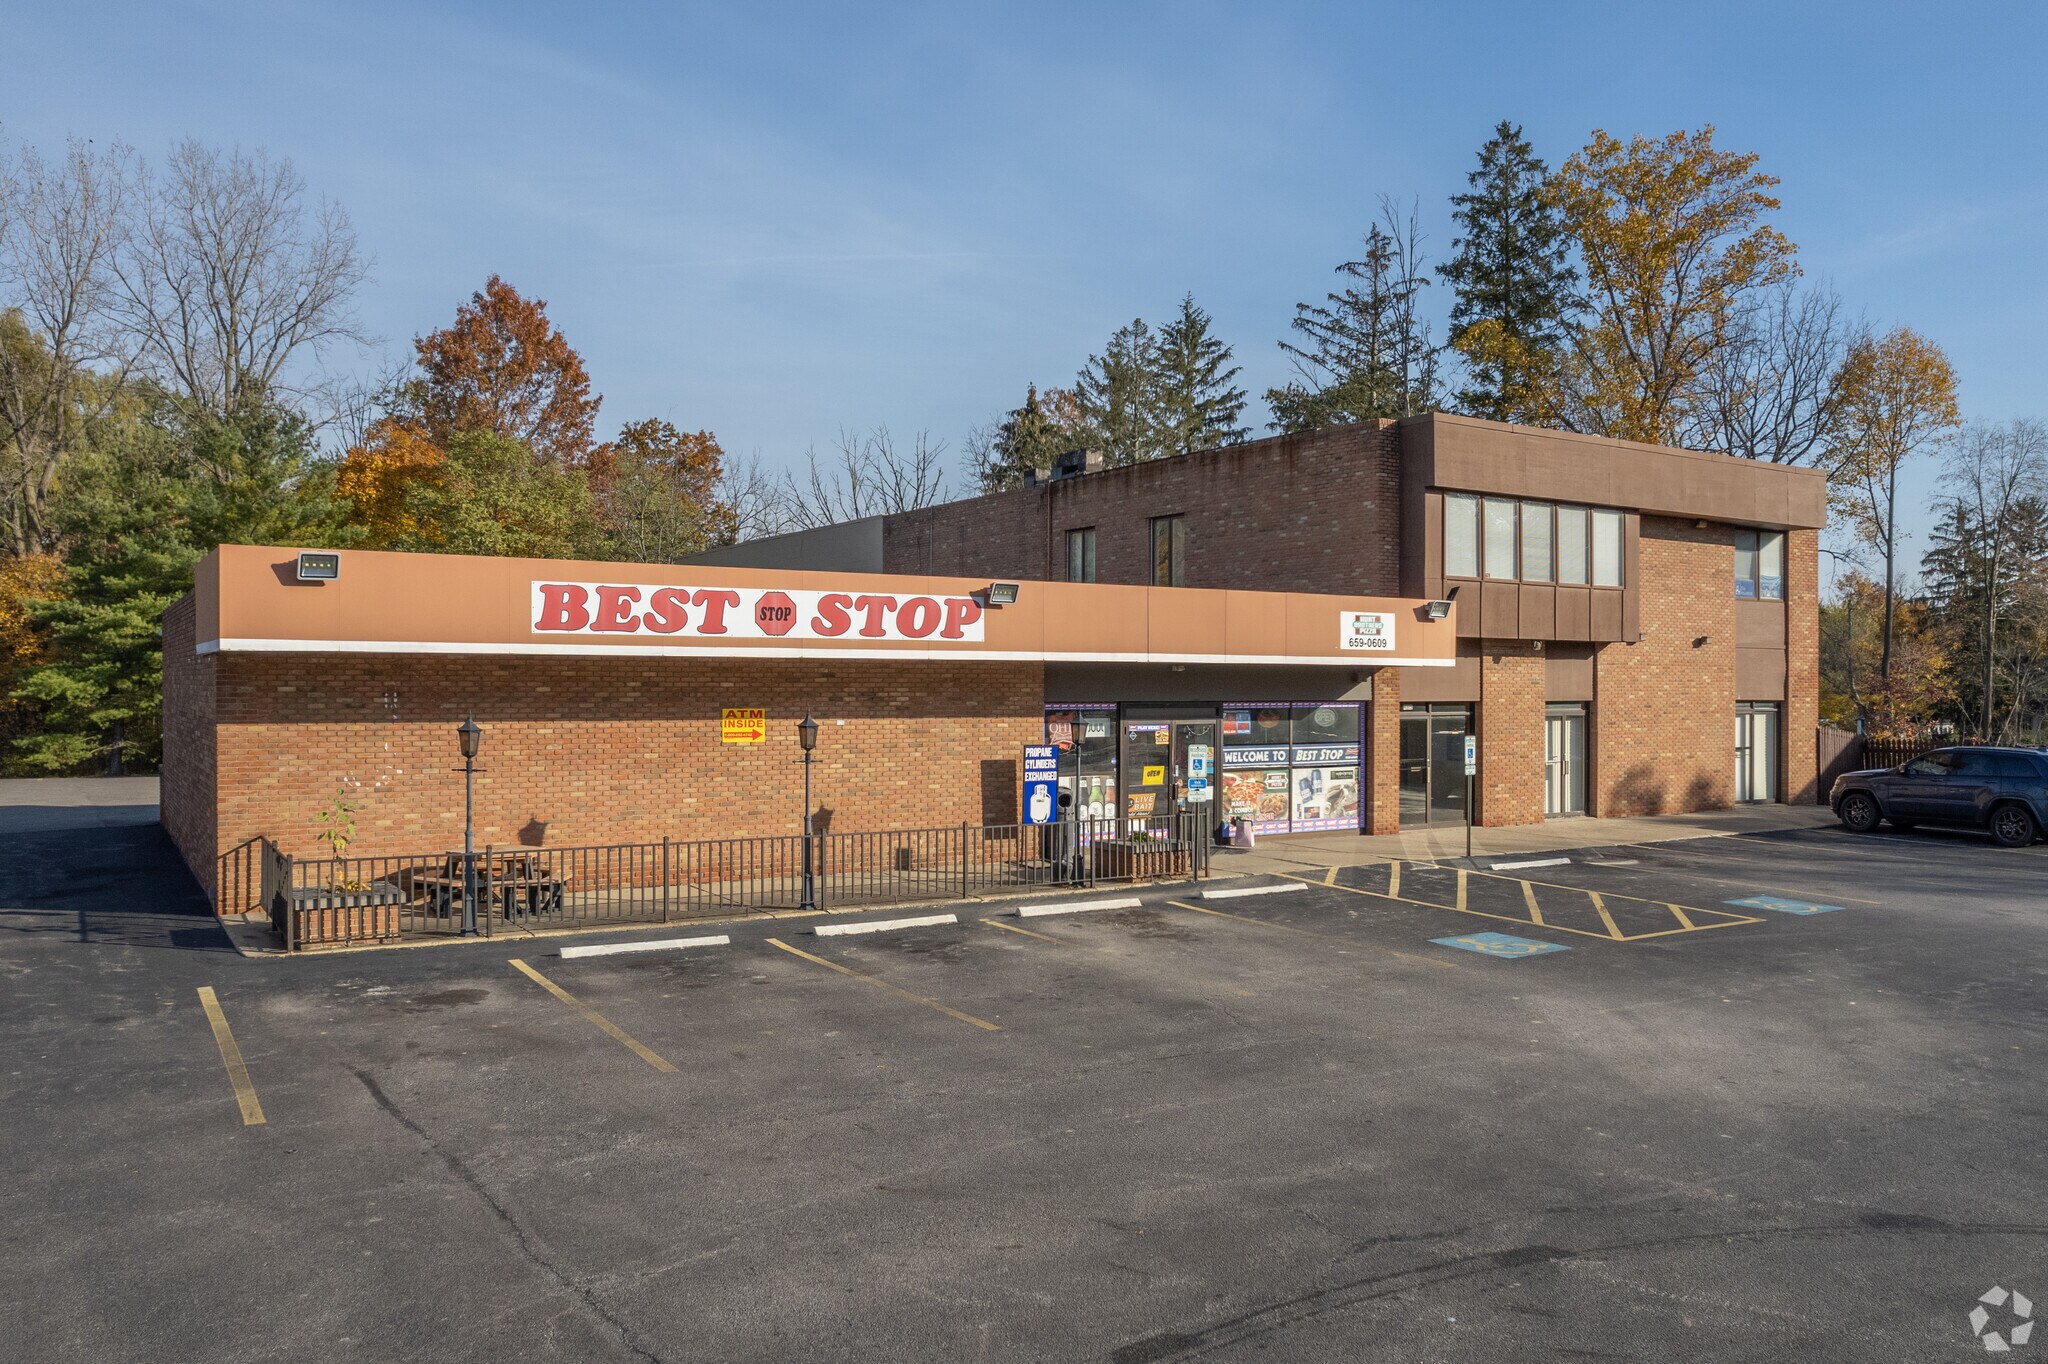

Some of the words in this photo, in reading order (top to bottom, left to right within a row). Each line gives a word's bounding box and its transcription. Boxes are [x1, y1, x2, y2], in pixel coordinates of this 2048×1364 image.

[534, 584, 740, 634] BEST
[760, 606, 791, 622] STOP
[810, 593, 982, 639] STOP
[1349, 638, 1387, 648] 659-0609
[725, 710, 763, 718] ATM
[724, 720, 763, 728] INSIDE
[1025, 747, 1053, 758] PROPANE
[1224, 751, 1269, 763] WELCOME
[1273, 750, 1286, 761] TO
[1296, 750, 1319, 761] BEST
[1320, 749, 1343, 760] STOP
[1025, 759, 1057, 769] CYLINDERS
[1025, 771, 1057, 781] EXCHANGED
[1135, 795, 1153, 803] LIVE
